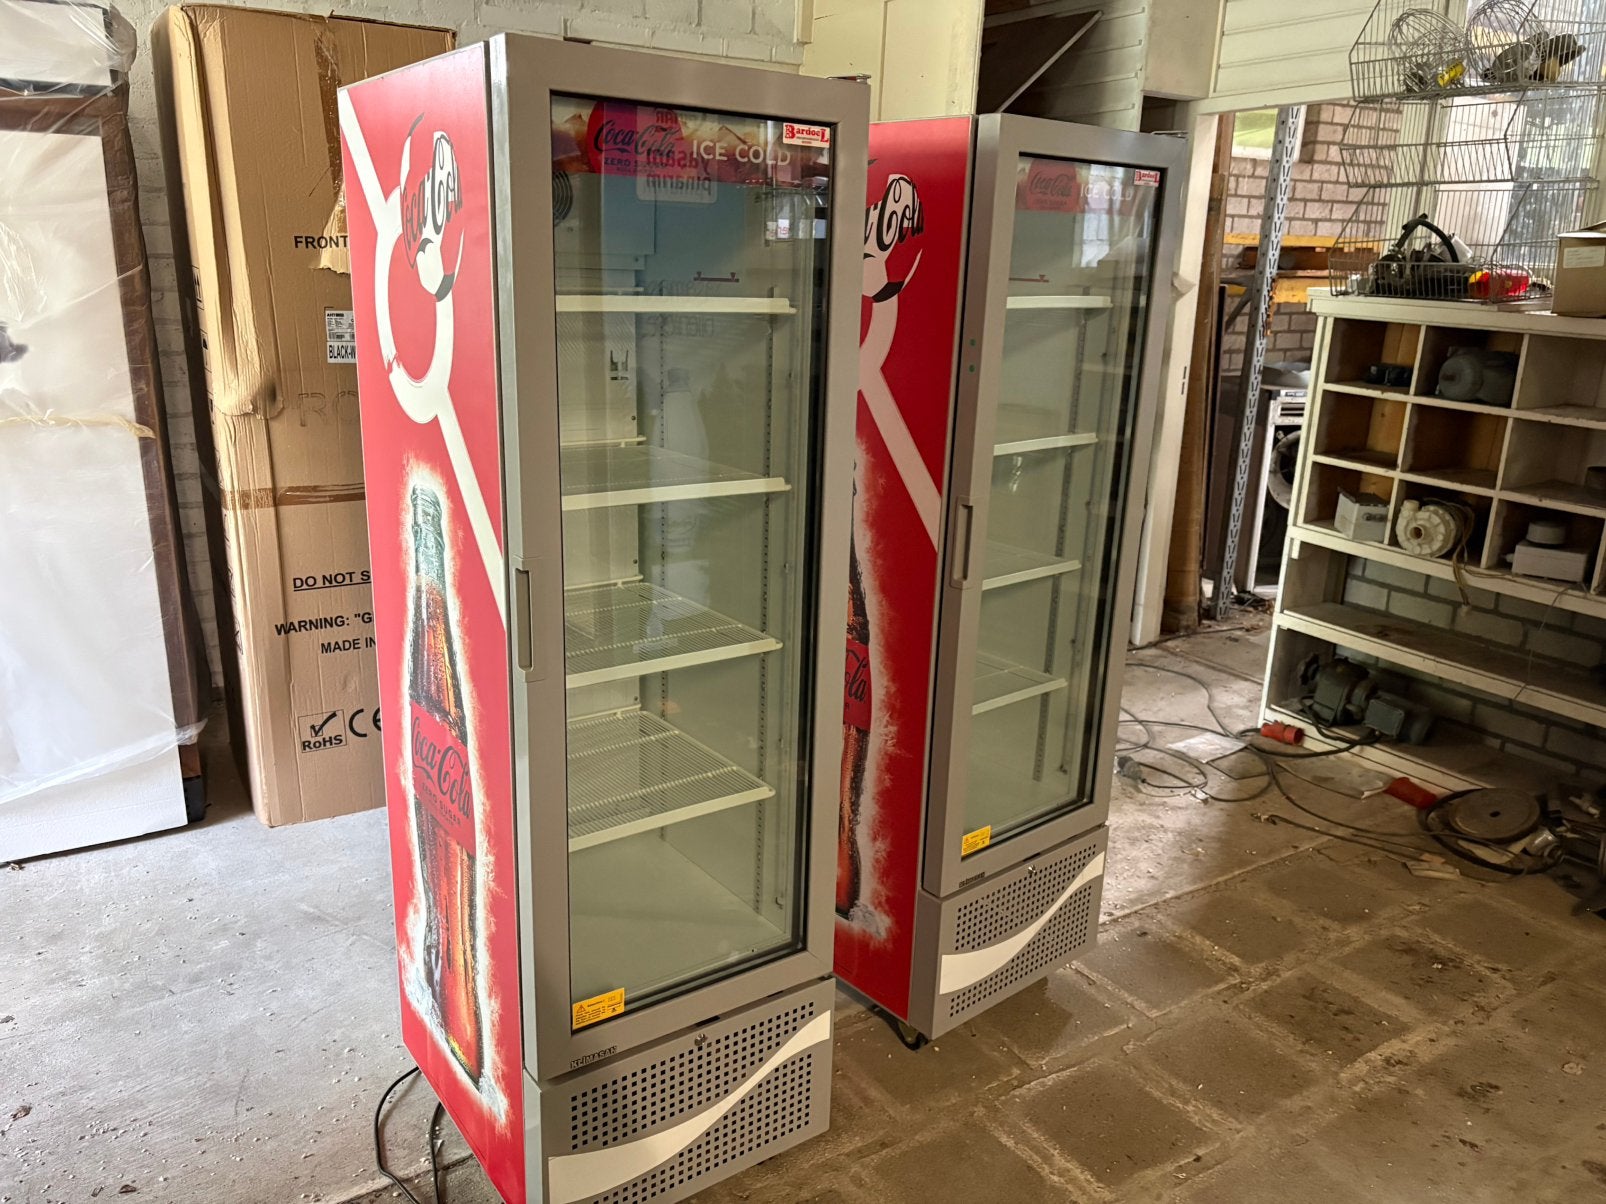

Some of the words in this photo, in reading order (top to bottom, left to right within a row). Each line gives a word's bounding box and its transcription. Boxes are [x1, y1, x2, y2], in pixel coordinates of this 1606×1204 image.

[692, 139, 728, 161] ICE
[735, 145, 791, 166] COLD
[1079, 183, 1100, 199] ICE
[1103, 185, 1134, 201] COLD
[293, 235, 348, 250] FRONT
[292, 575, 317, 588] DO
[322, 571, 355, 586] NOT
[274, 614, 350, 636] WARNING:
[320, 637, 361, 655] MADE
[301, 733, 344, 751] RoHS
